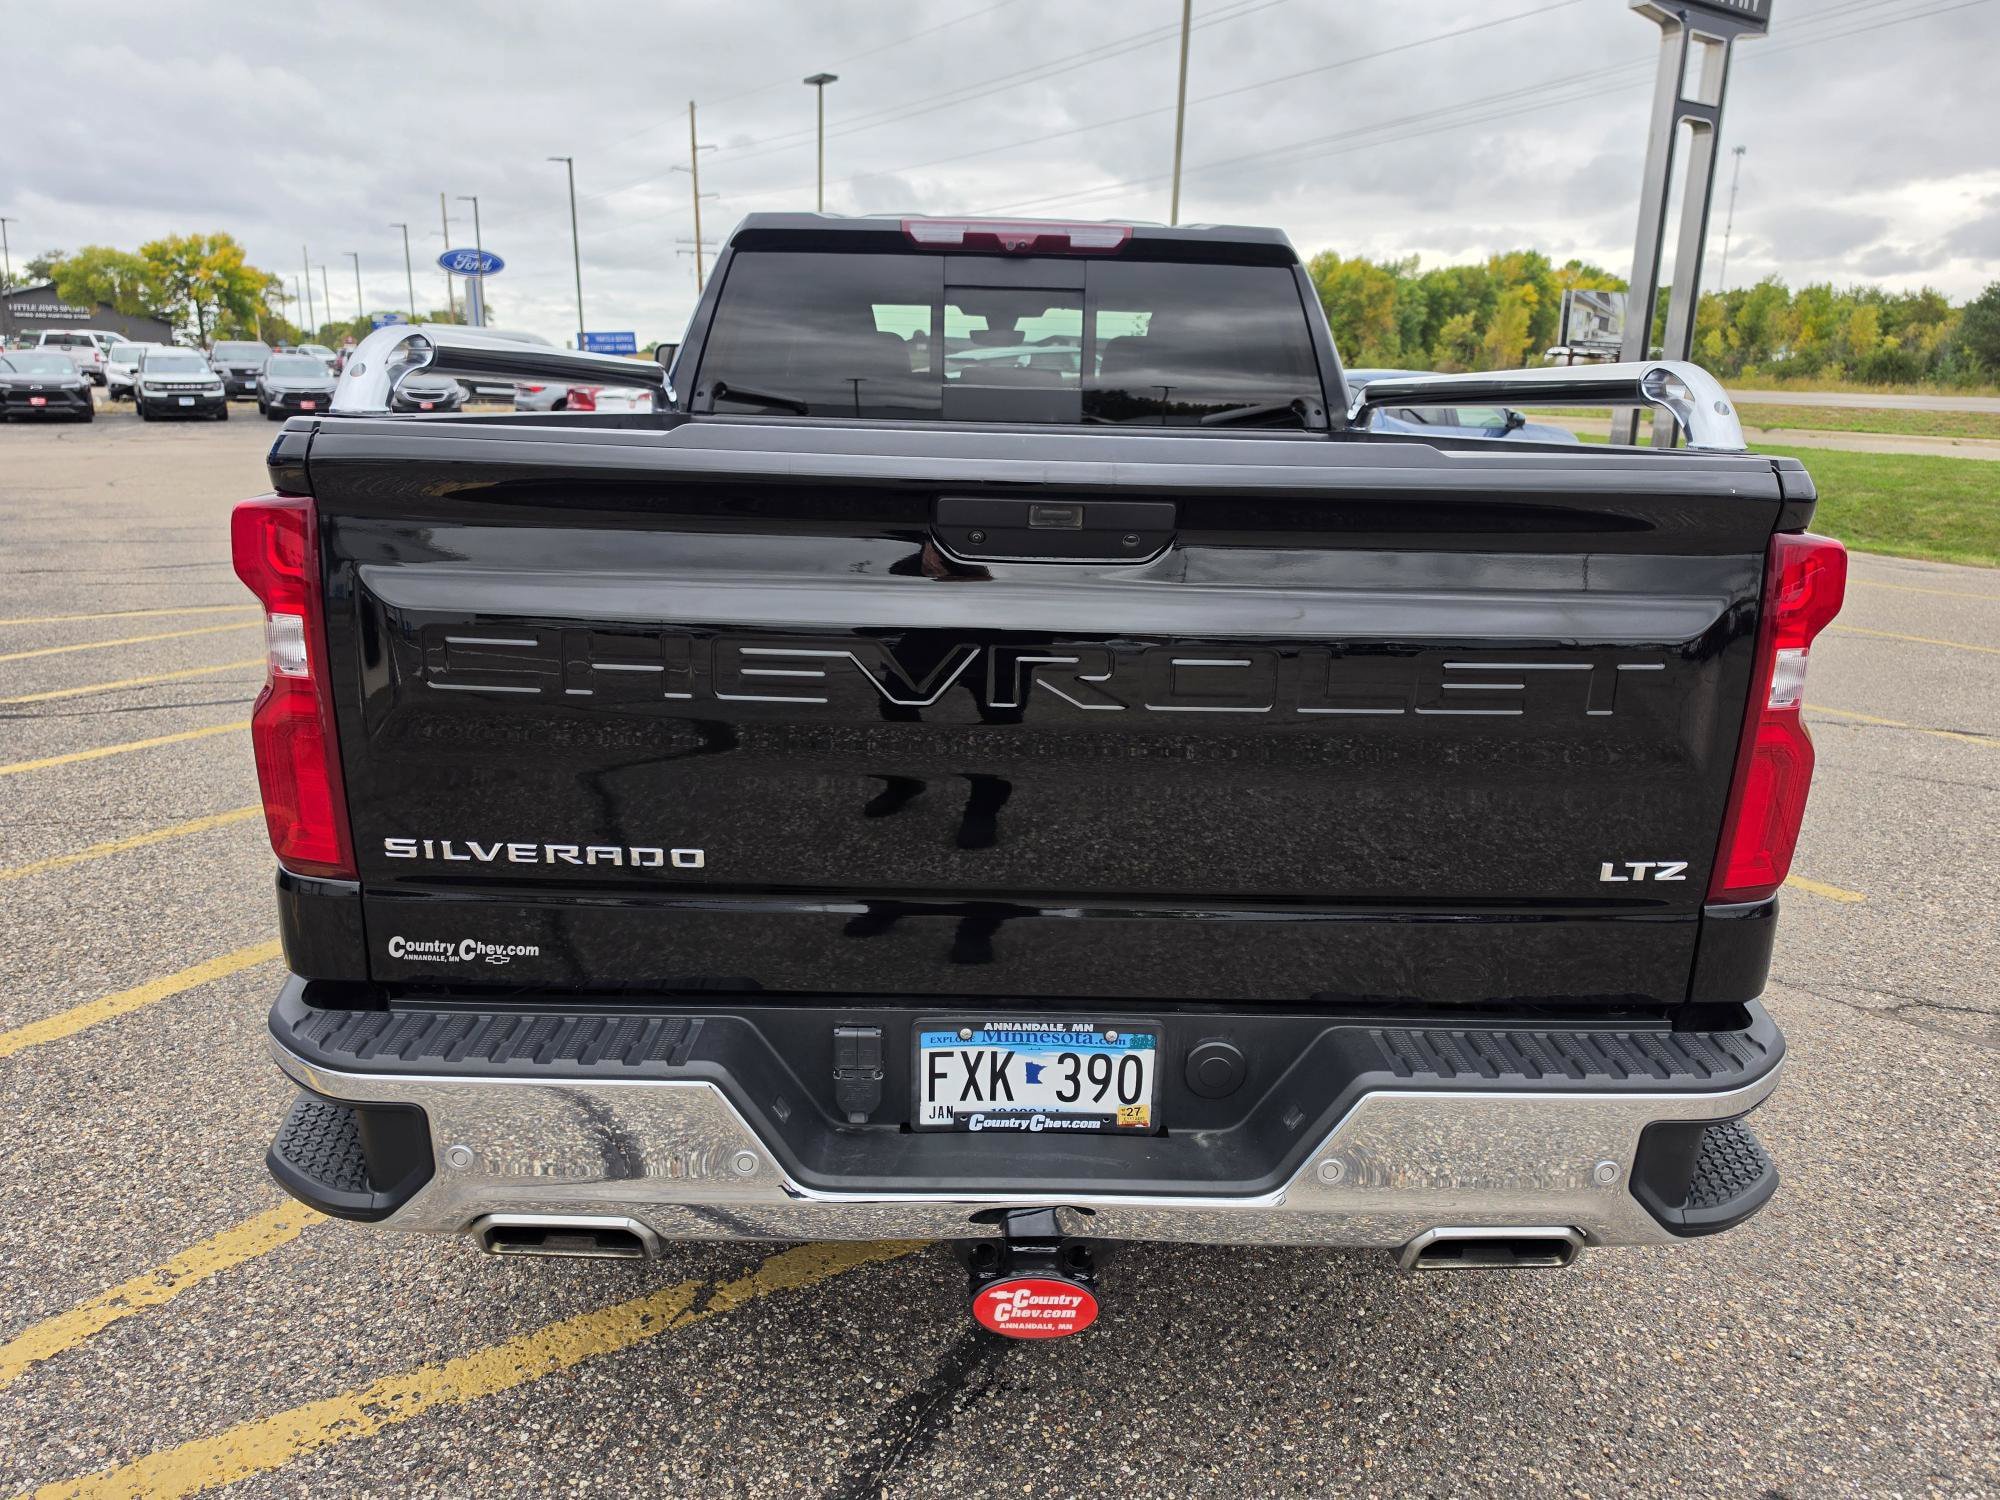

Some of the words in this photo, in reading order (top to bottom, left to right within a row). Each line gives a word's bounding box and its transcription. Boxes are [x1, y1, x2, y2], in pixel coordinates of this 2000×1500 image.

[453, 254, 493, 271] Ford
[422, 624, 1668, 717] CHEVROLET
[384, 837, 705, 868] SILVERADO
[1599, 862, 1688, 881] LTZ
[984, 1022, 1067, 1033] ANNANDALE,
[1072, 1023, 1094, 1032] MN
[928, 1051, 1015, 1102] FXK
[1055, 1053, 1143, 1105] 390
[929, 1106, 954, 1119] JAN
[1126, 1107, 1142, 1117] 27
[1012, 1288, 1083, 1308] Country
[993, 1303, 1077, 1322] Chev.com
